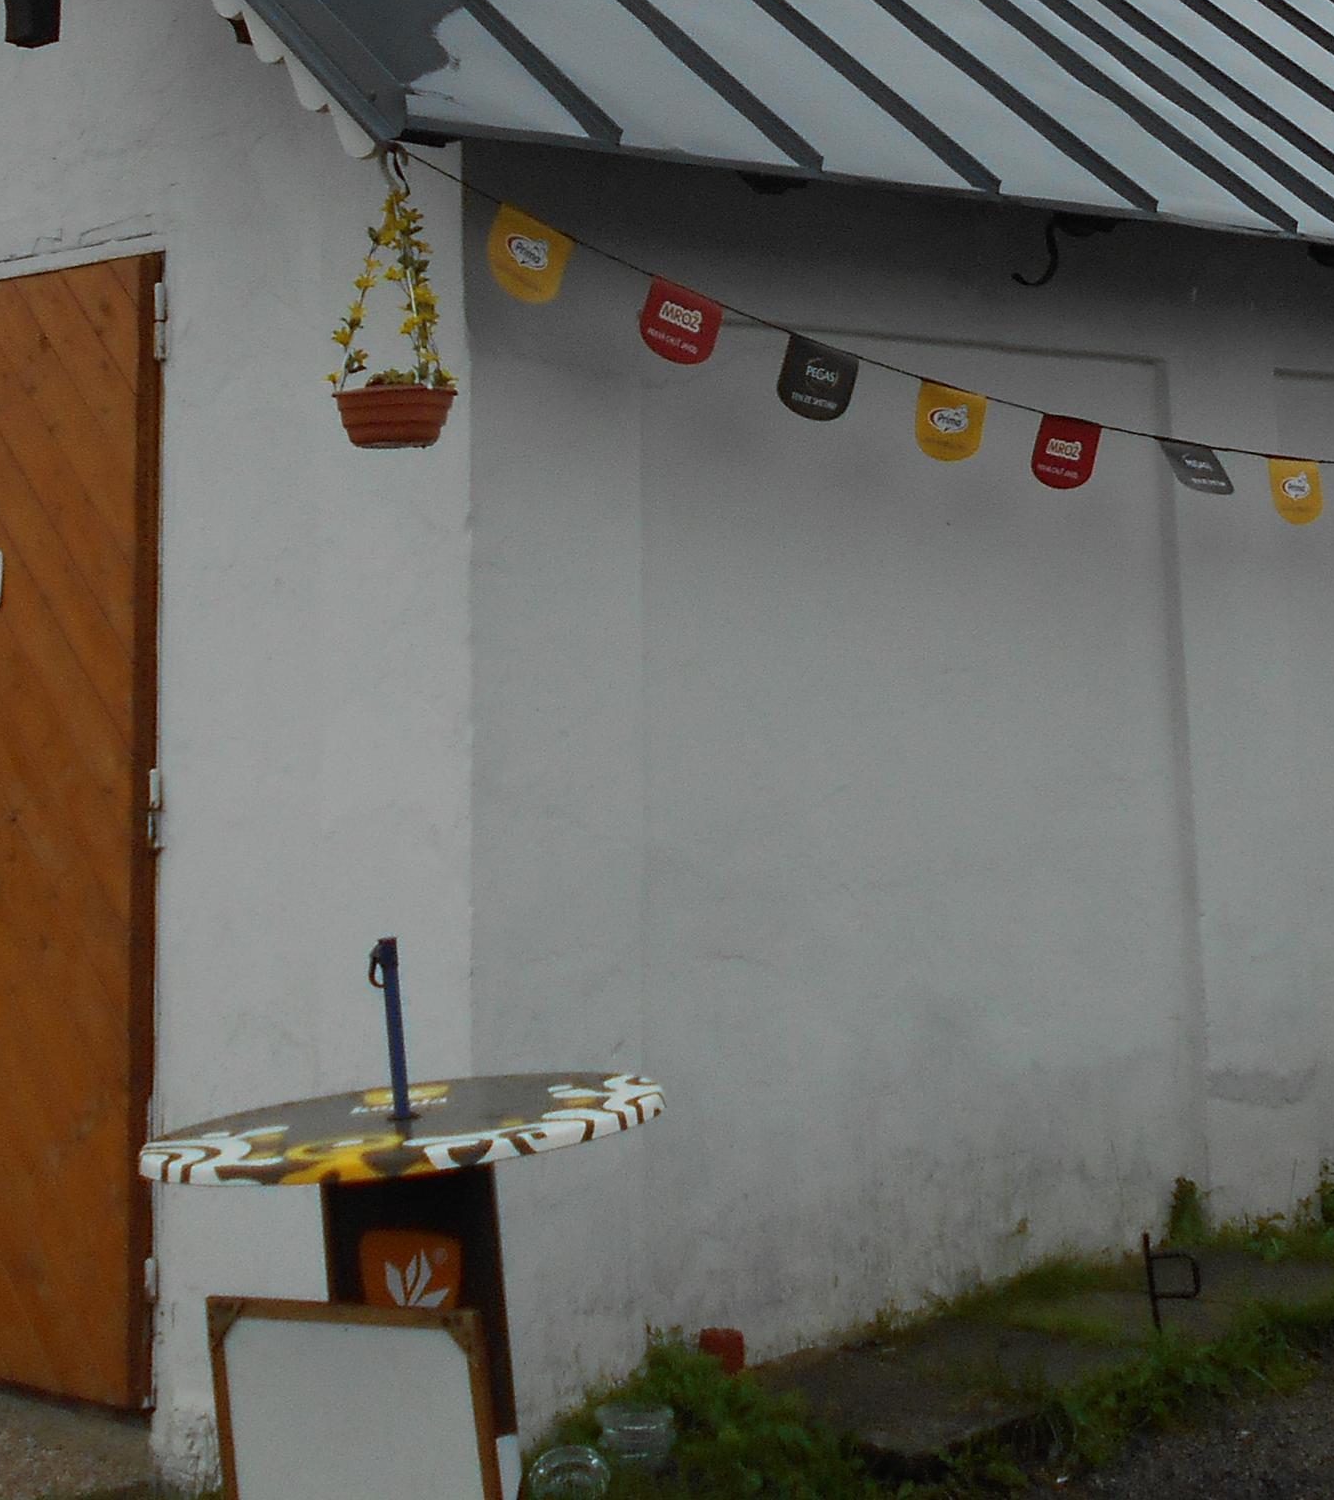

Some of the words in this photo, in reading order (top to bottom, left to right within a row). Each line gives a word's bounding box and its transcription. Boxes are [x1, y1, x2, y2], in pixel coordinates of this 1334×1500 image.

[661, 302, 702, 332] MROŽ
[806, 365, 836, 382] PEGAS
[1047, 439, 1082, 460] MROŽ
